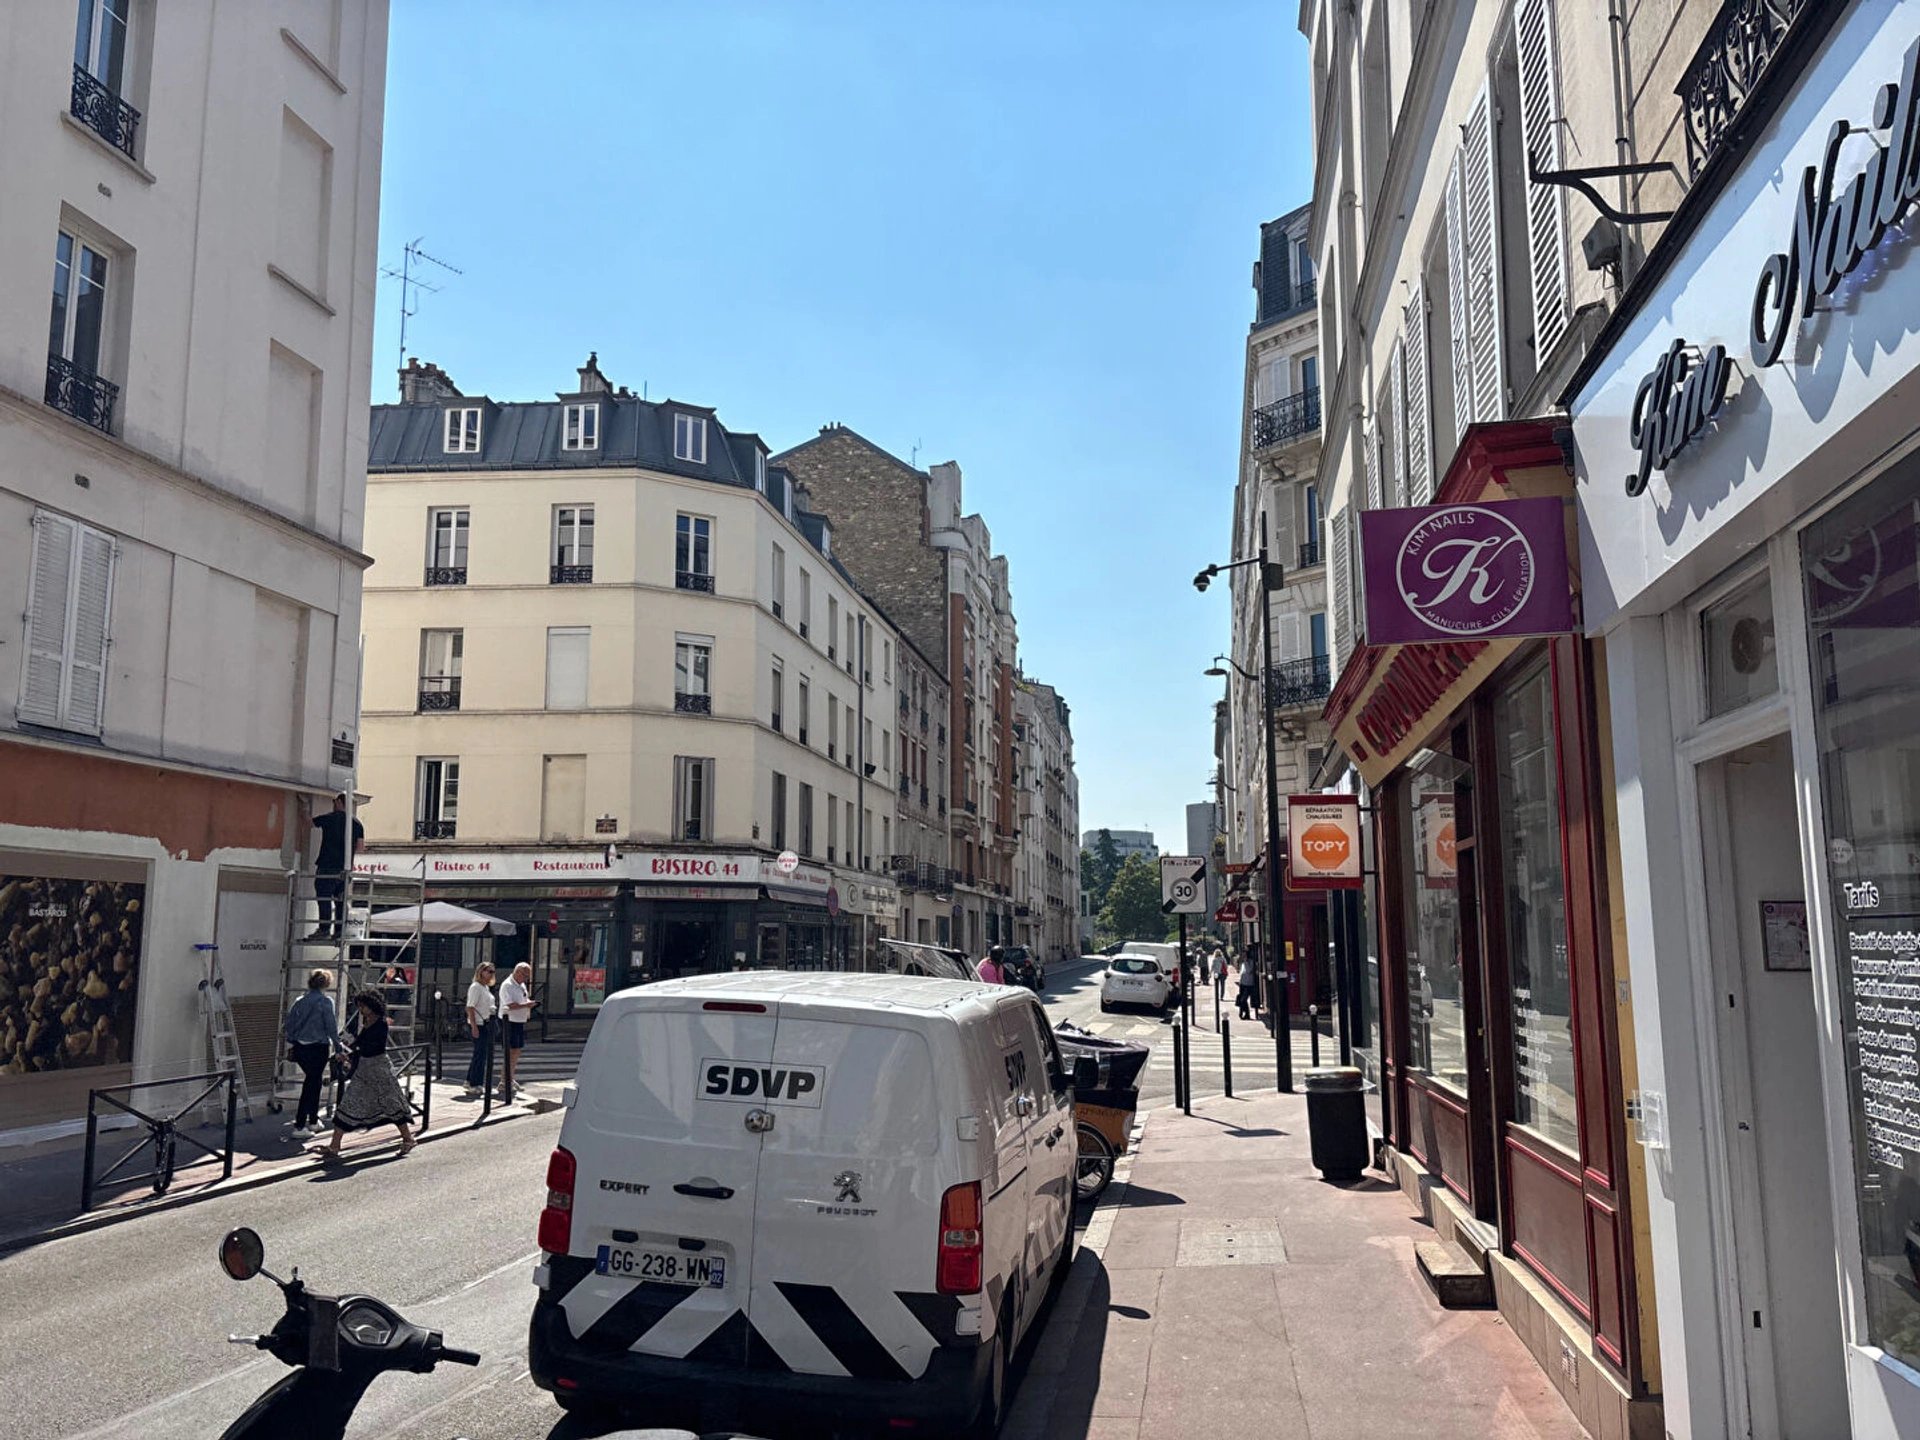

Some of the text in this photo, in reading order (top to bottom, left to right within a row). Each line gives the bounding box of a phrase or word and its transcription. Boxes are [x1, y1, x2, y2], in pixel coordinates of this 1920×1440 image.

[1626, 337, 1732, 497] Kim
[1407, 512, 1475, 556] KIM NAILS
[1425, 610, 1483, 631] MANUCURE
[1491, 606, 1511, 624] CILS
[1304, 840, 1346, 852] TOPY
[434, 861, 475, 872] Bistro
[651, 858, 719, 876] BISTRO
[1175, 886, 1192, 897] 30
[1844, 882, 1879, 907] Tarifs
[1850, 931, 1917, 954] Beauté des pieds
[1852, 956, 1890, 975] Manucure
[1854, 978, 1879, 997] Forfait
[1855, 1002, 1876, 1021] Pose
[1876, 1004, 1887, 1022] de
[1887, 1007, 1914, 1027] vernis
[1858, 1026, 1917, 1053] Pose de vernis
[1859, 1048, 1919, 1077] Pose complète
[705, 1065, 816, 1100] SDVP
[1862, 1072, 1882, 1094] Pose
[1864, 1097, 1904, 1126] Extension
[600, 1179, 650, 1195] EXPERT
[817, 1206, 878, 1216] PEUGEOT
[611, 1249, 710, 1281] GG-238-WN
